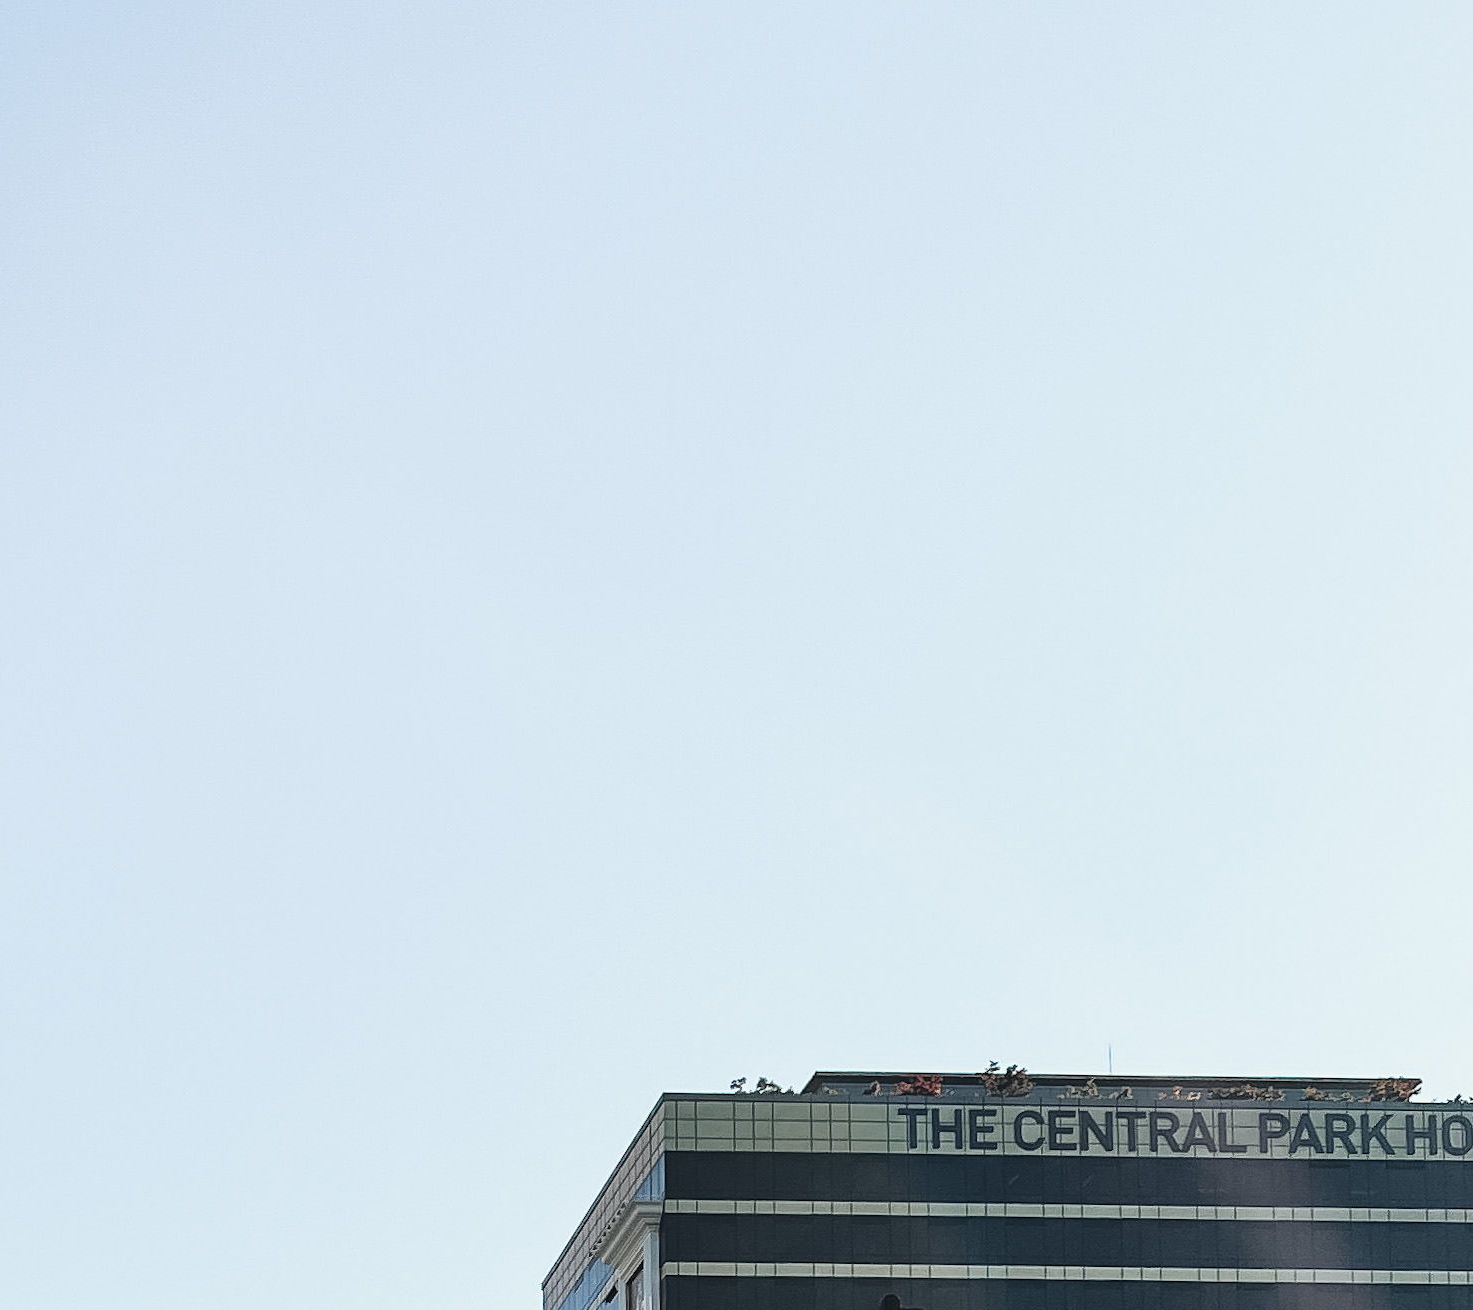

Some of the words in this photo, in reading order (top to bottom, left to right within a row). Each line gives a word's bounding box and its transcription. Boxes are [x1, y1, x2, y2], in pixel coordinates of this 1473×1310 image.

[897, 1107, 998, 1150] THE
[1013, 1109, 1246, 1154] CENTRAL
[1258, 1112, 1396, 1156] PARK
[1405, 1114, 1473, 1157] HO
